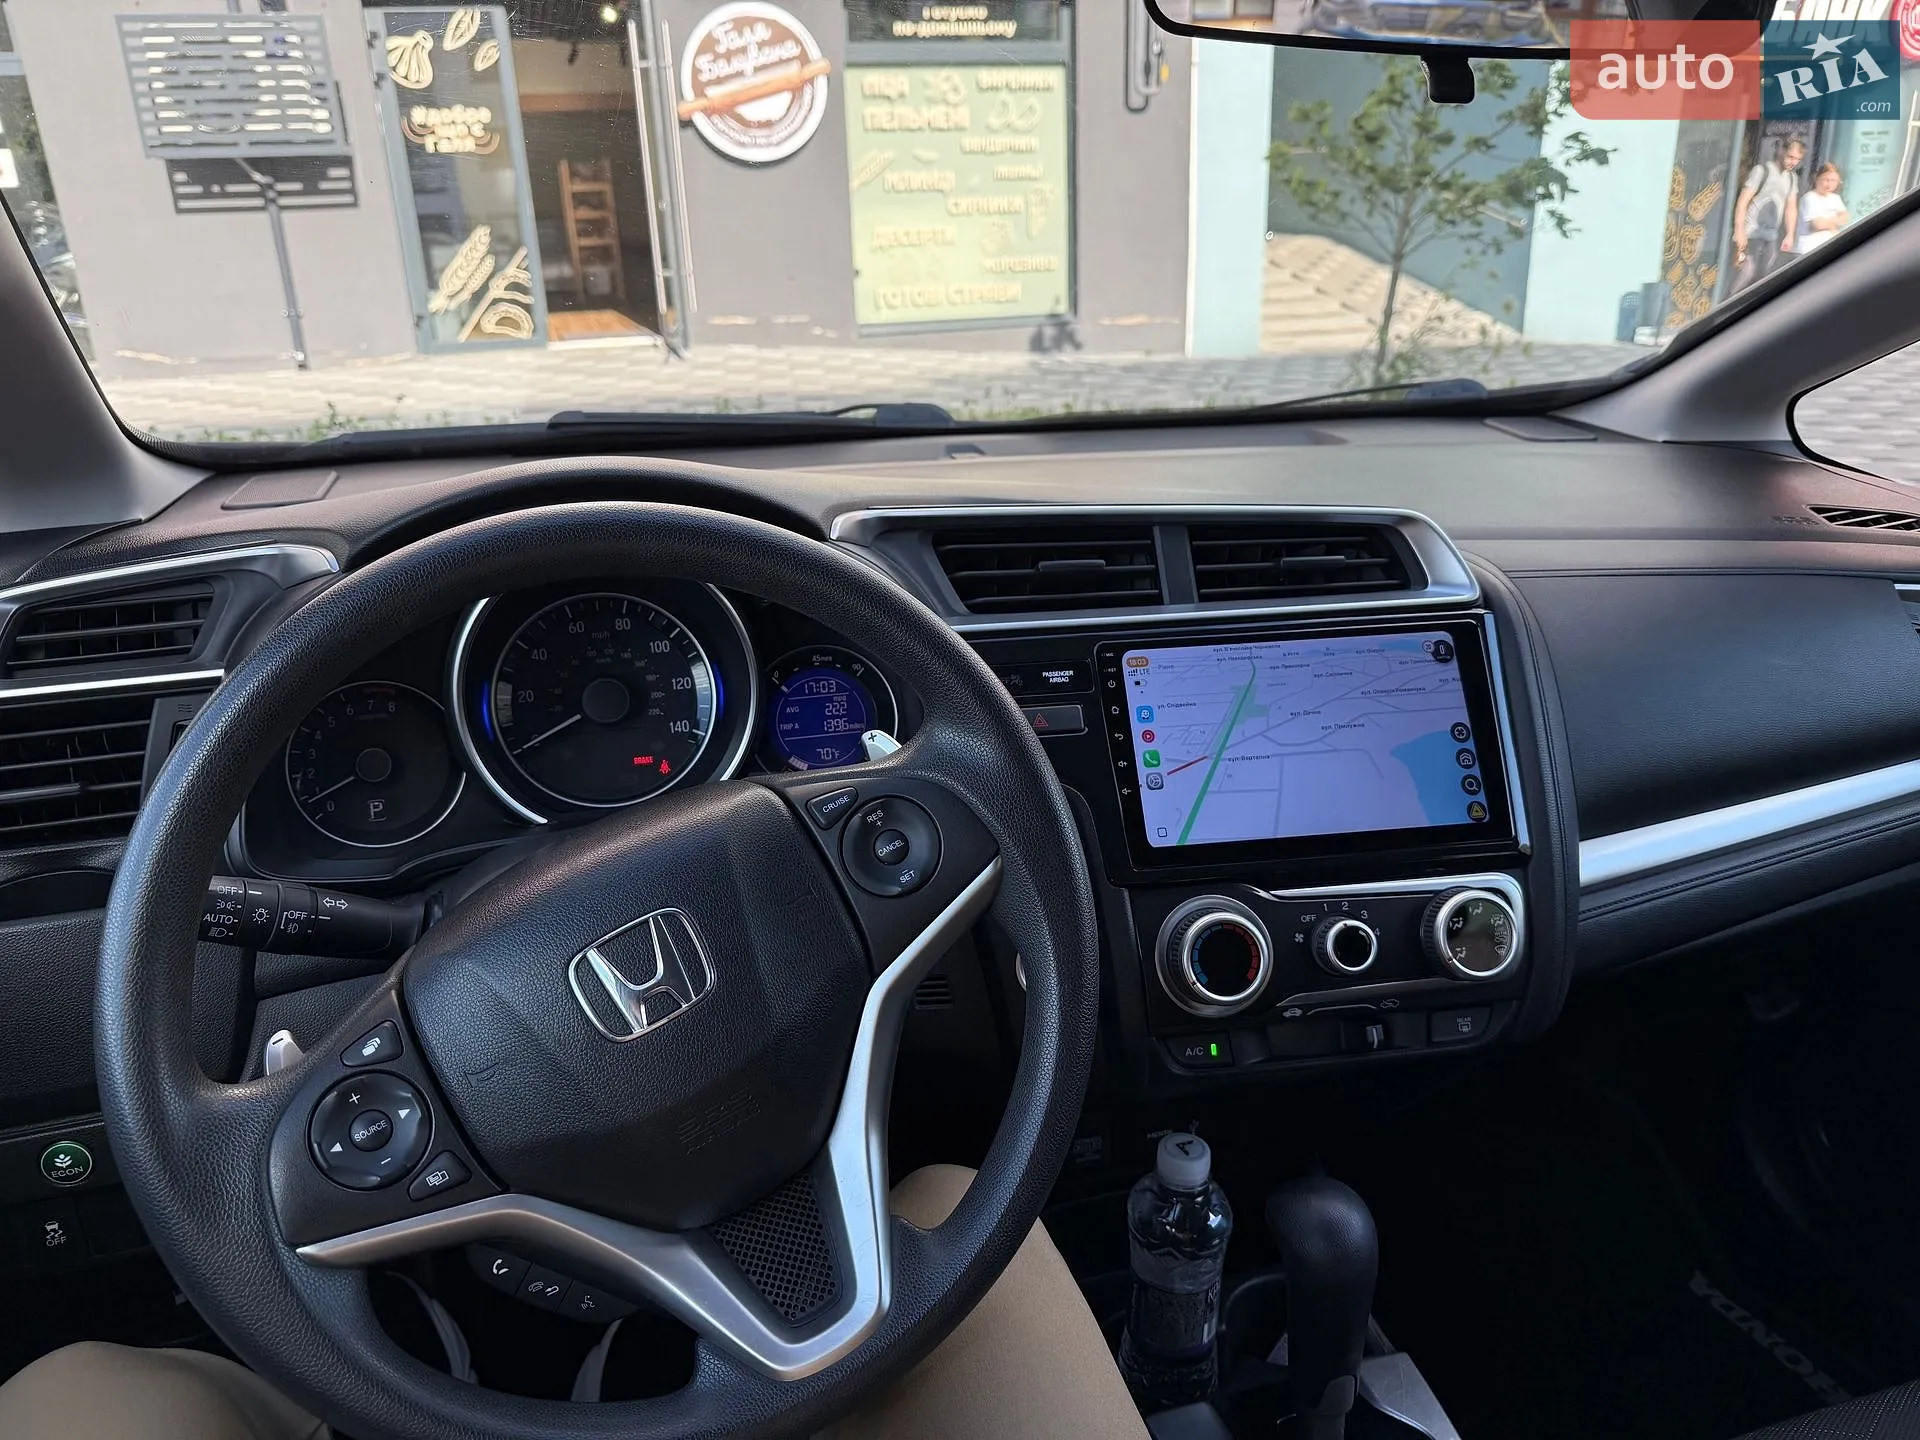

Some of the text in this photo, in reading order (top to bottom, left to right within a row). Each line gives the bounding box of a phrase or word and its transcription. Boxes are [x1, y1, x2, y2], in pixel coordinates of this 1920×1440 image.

[568, 621, 585, 634] 60
[615, 618, 631, 631] 80
[649, 640, 670, 654] 100
[531, 649, 548, 661] 40
[1042, 670, 1074, 678] PASSENGER
[671, 677, 692, 691] 120
[804, 681, 837, 693] 17:03
[518, 690, 535, 703] 20
[346, 705, 354, 715] 6
[367, 701, 374, 711] 7
[388, 702, 396, 712] 8
[327, 717, 336, 727] 5
[670, 719, 691, 734] 140
[632, 757, 654, 765] BRAKE
[327, 801, 335, 812] 0
[822, 794, 851, 813] CRUISE
[370, 802, 384, 819] P
[866, 809, 884, 823] RES
[877, 839, 905, 857] CANCEL
[899, 869, 915, 884] SET
[217, 885, 238, 896] OFF
[1341, 901, 1349, 910] 2
[203, 912, 234, 924] AUTO
[287, 910, 308, 920] OFF
[1300, 914, 1317, 923] OFF
[1360, 909, 1368, 919] 3
[1185, 1045, 1205, 1057] A/C
[354, 1119, 388, 1142] SOURCE
[51, 1165, 84, 1178] ECON
[46, 1236, 66, 1247] OFF
